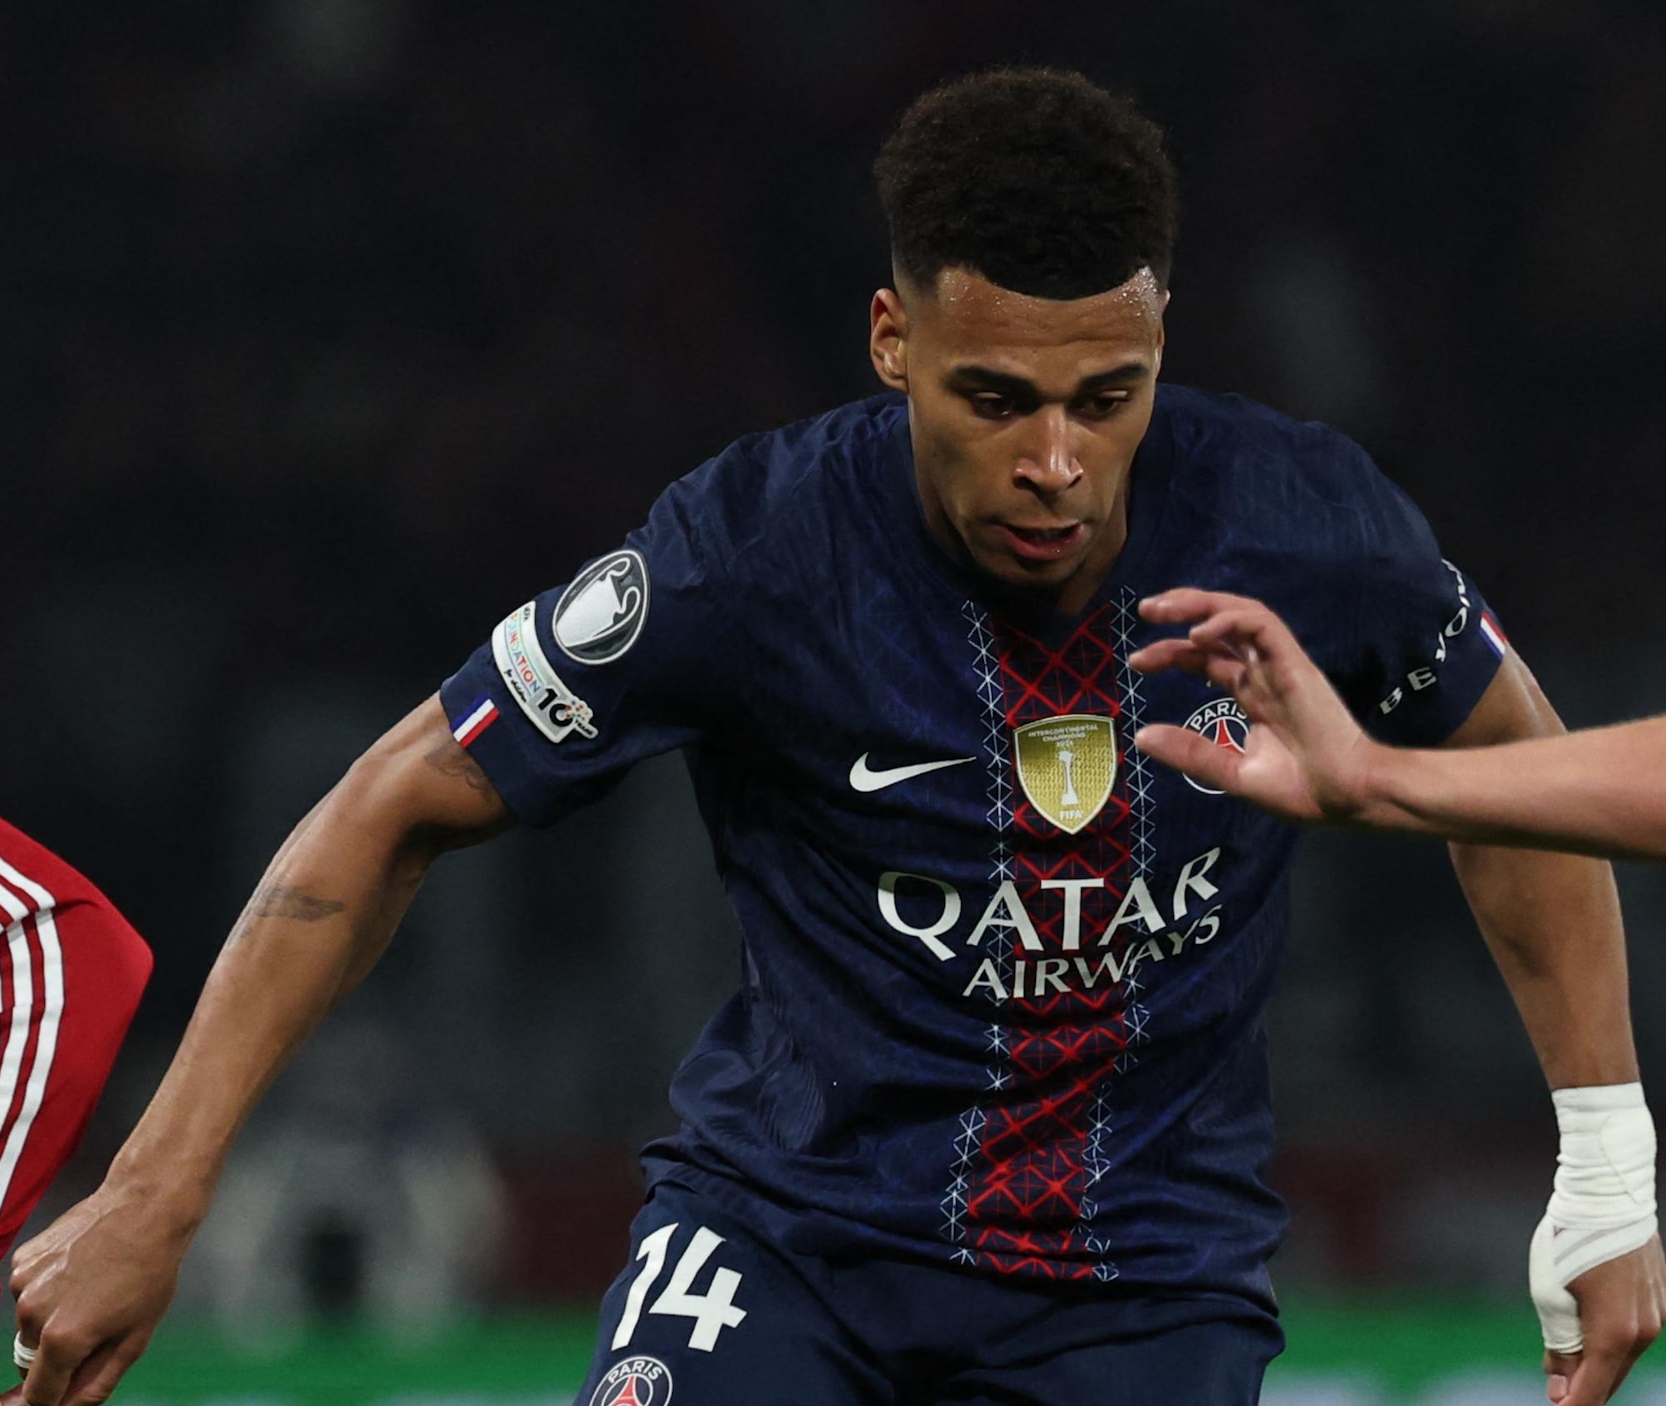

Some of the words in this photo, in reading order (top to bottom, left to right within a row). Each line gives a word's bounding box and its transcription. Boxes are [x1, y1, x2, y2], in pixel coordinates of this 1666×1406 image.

[1059, 809, 1084, 820] FIFA
[877, 846, 1221, 961] QATAR
[962, 904, 1223, 999] AIRWAYS
[611, 1222, 748, 1352] 14
[607, 1360, 663, 1384] PARIS
